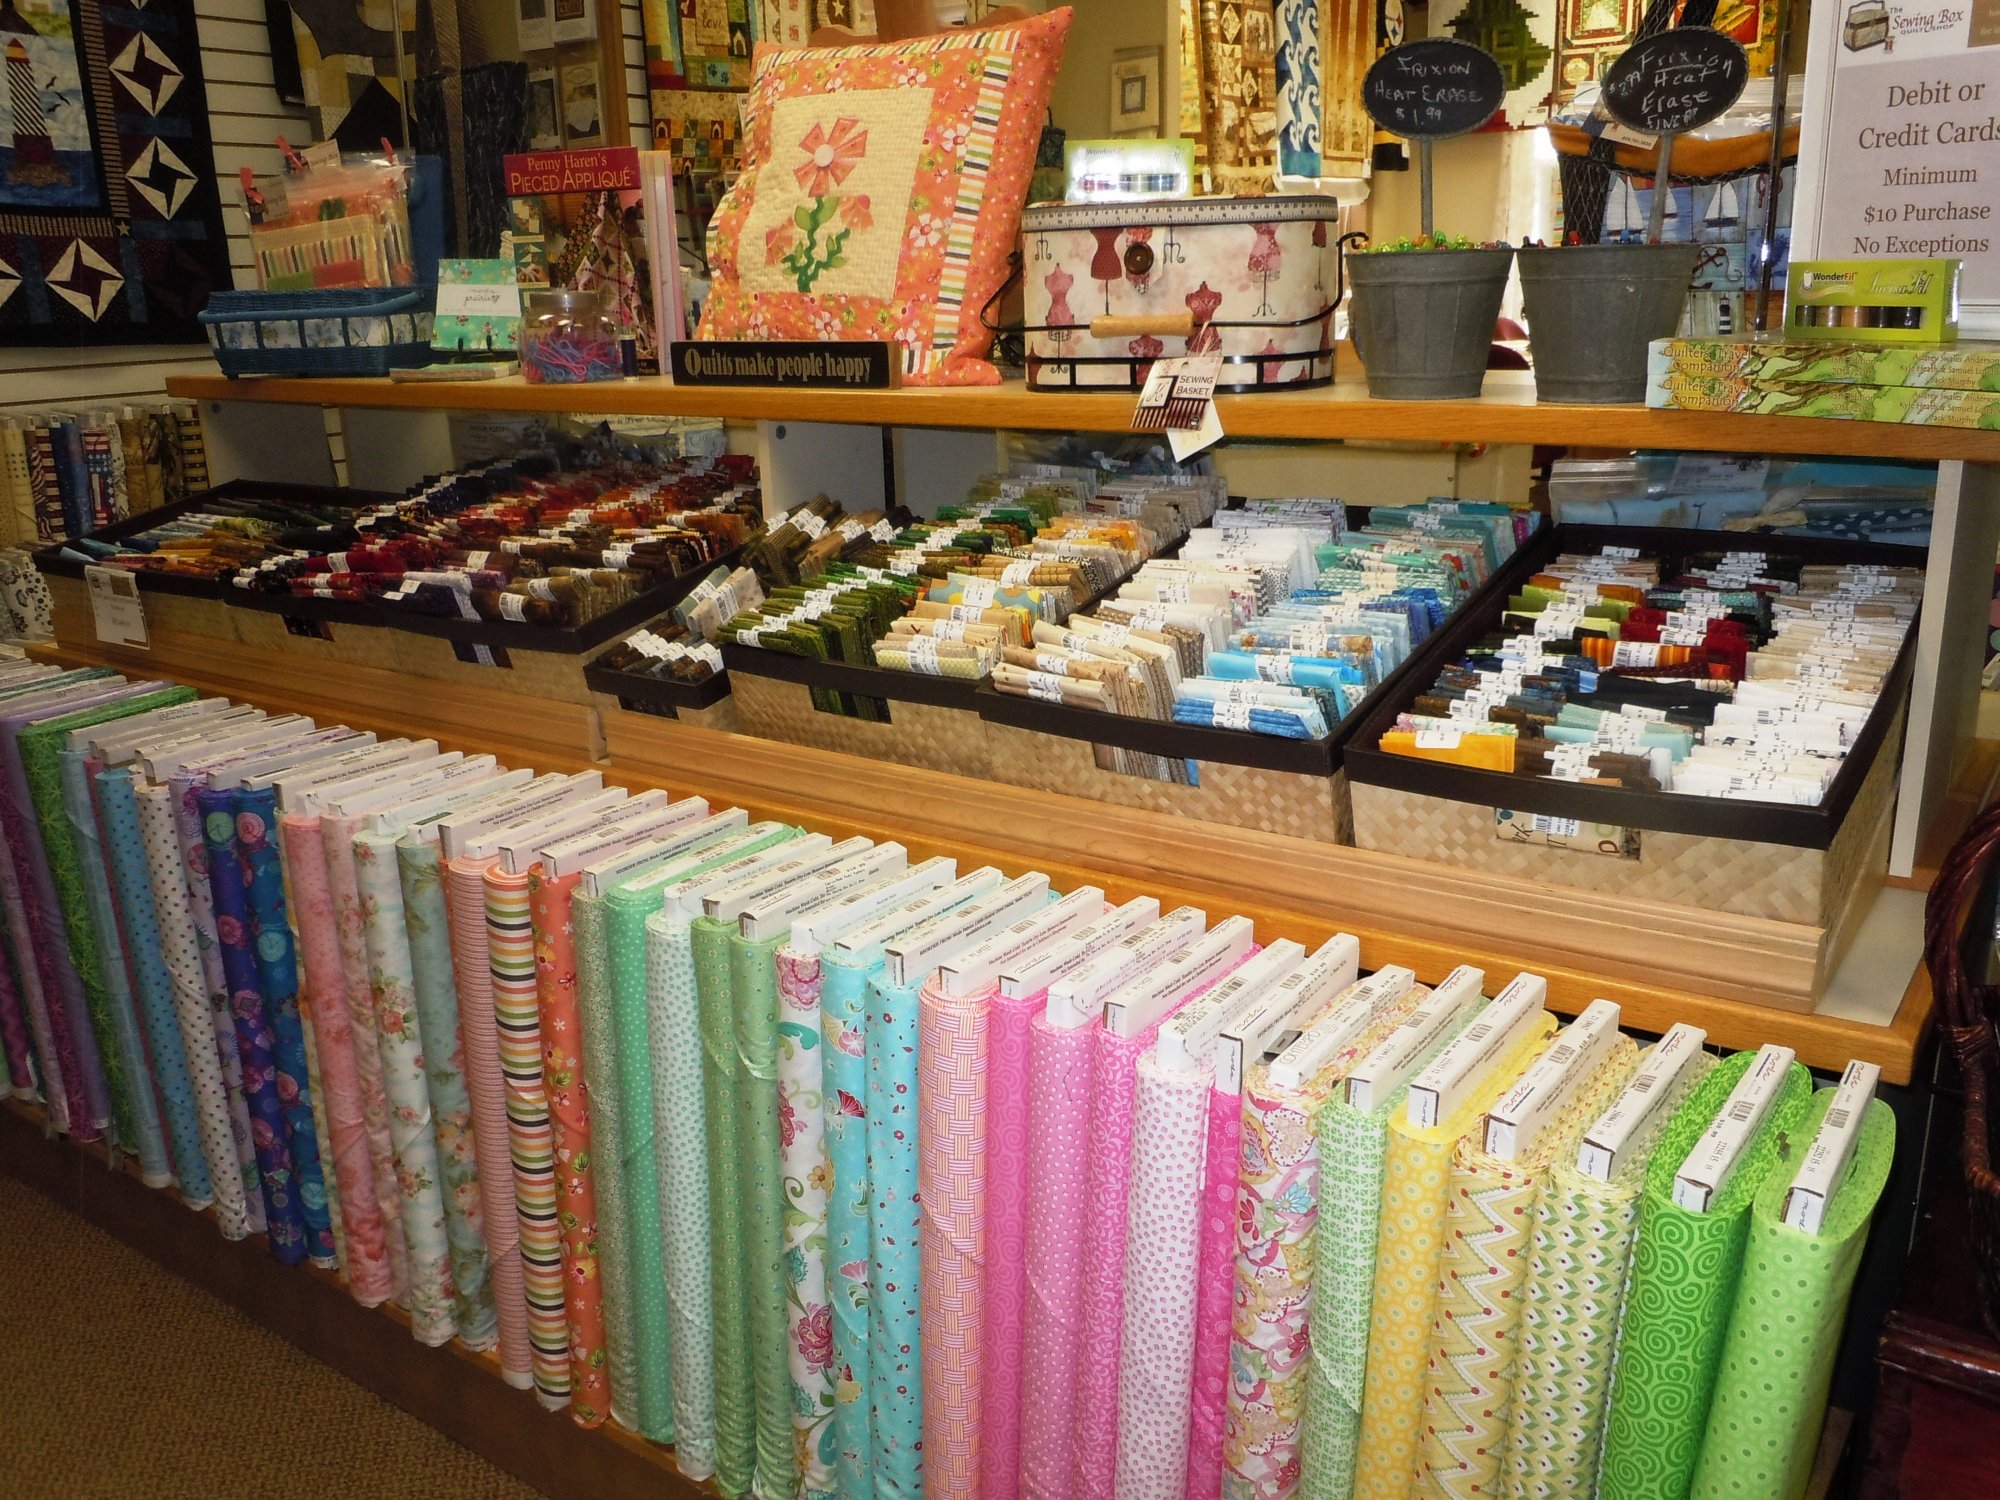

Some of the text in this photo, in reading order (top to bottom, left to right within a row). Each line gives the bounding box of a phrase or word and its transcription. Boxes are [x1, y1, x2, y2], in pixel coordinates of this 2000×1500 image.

[1892, 9, 1964, 31] Sewing Box
[1932, 23, 1954, 32] SHOP
[1653, 66, 1718, 87] Heat
[1375, 80, 1483, 103] HEAT ERASE
[1641, 90, 1712, 115] Erase
[1887, 80, 1986, 108] Debit or
[1859, 123, 1930, 149] Credit
[527, 152, 608, 174] Penny Haren's
[511, 165, 632, 194] PIECED APPLIQUÉ
[1883, 166, 1978, 187] Minimum
[1864, 201, 1991, 225] $10 Purchase
[1853, 234, 1990, 257] No Exceptions
[1813, 271, 1855, 281] WonderFil
[1716, 346, 1751, 360] Travel
[684, 348, 872, 383] Quilts make people happy
[1672, 359, 1740, 374] Companion
[1179, 375, 1214, 384] SEWING
[1715, 380, 1750, 394] Travel
[1949, 378, 1976, 387] Murphy
[1176, 386, 1210, 396] BASKET
[1671, 394, 1739, 408] Companion
[1949, 416, 1976, 425] Murphy
[1665, 1031, 1687, 1057] moda
[1762, 1052, 1781, 1081] moda
[1502, 1082, 1531, 1113] moda
